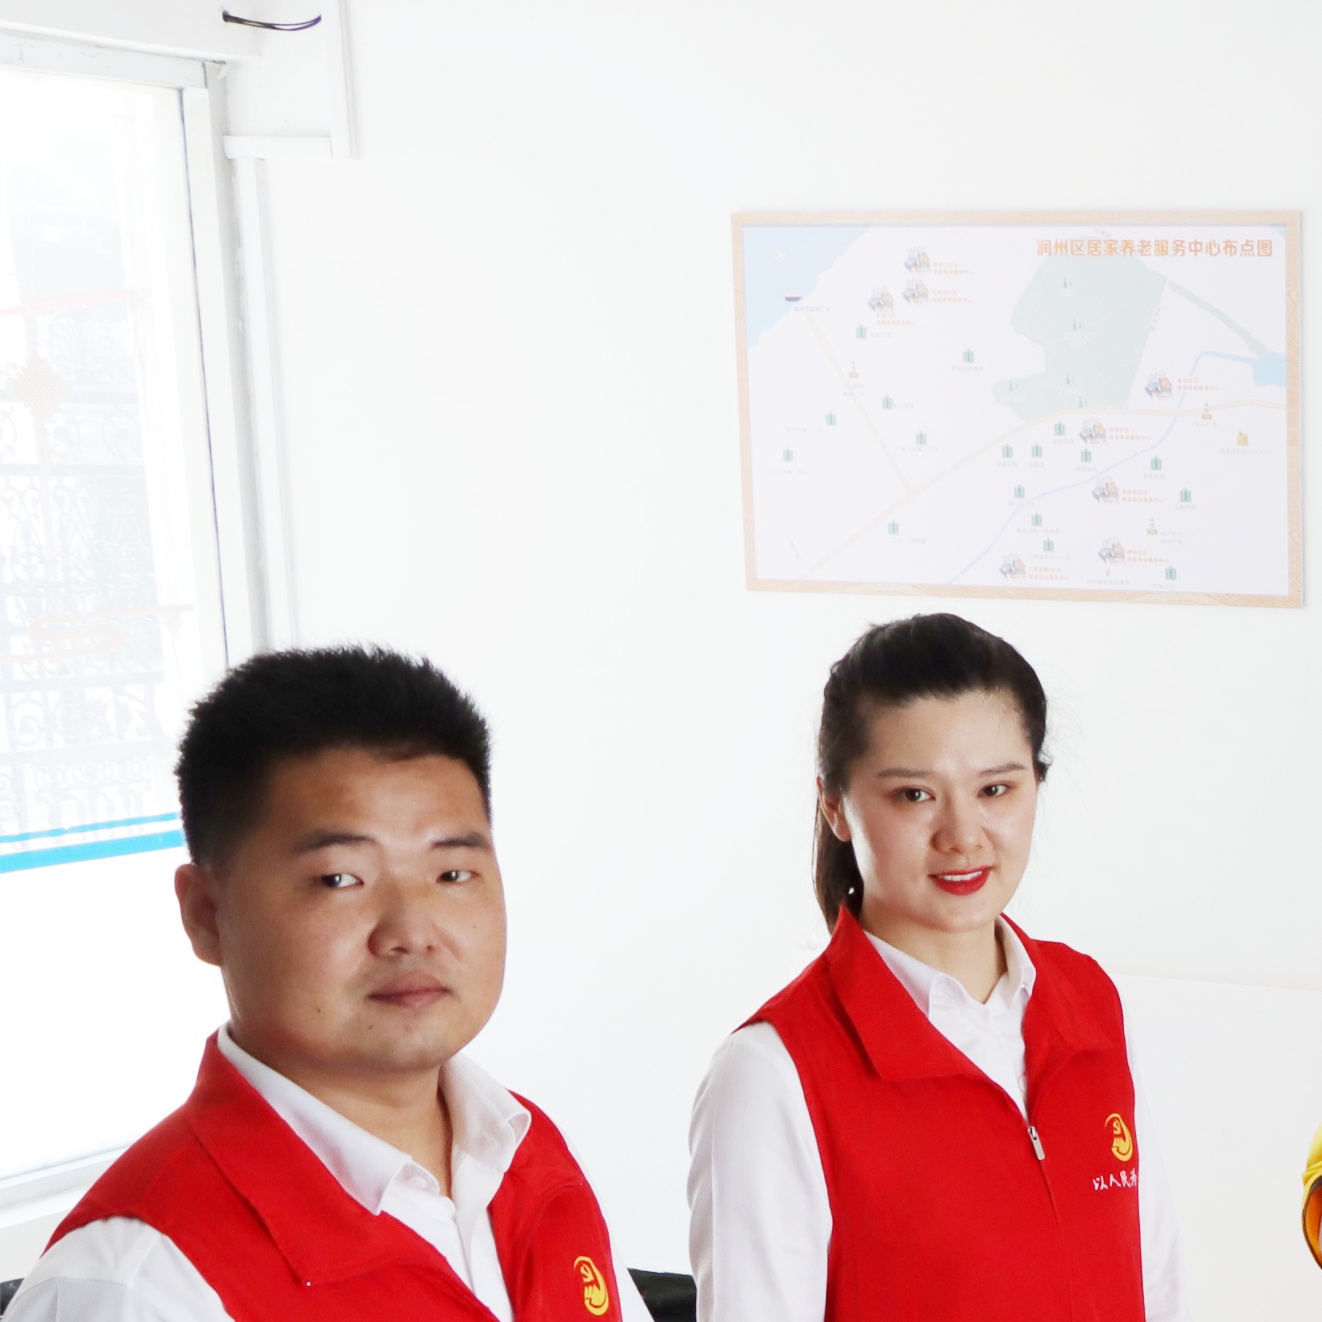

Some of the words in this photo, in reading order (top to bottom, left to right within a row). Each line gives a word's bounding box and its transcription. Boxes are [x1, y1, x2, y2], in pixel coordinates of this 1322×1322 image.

[1036, 238, 1274, 258] 润州区居家养老服务中心布点图
